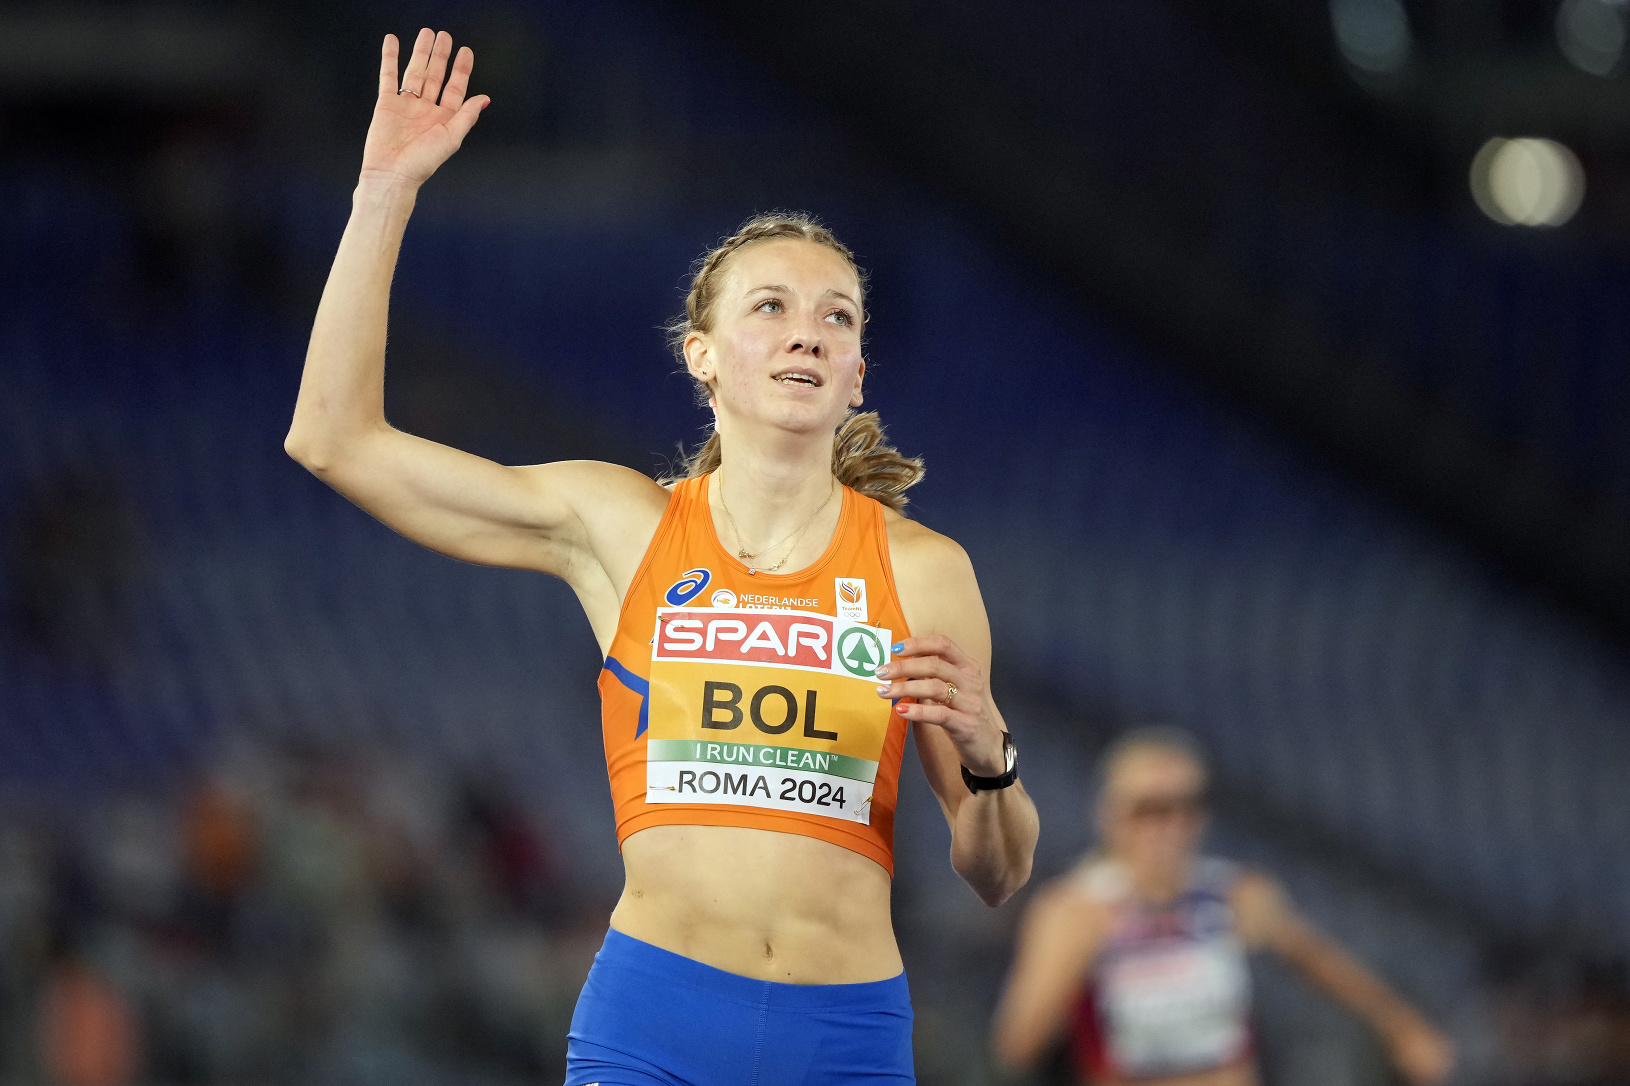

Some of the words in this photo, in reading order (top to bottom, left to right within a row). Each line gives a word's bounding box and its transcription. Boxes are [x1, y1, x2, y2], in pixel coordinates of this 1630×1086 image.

[739, 593, 819, 607] NEDERLANDSE
[663, 619, 828, 661] SPAR
[701, 680, 838, 741] BOL
[695, 743, 701, 759] I
[706, 743, 753, 762] RUN
[678, 770, 771, 798] ROMA
[779, 777, 846, 809] 2024
